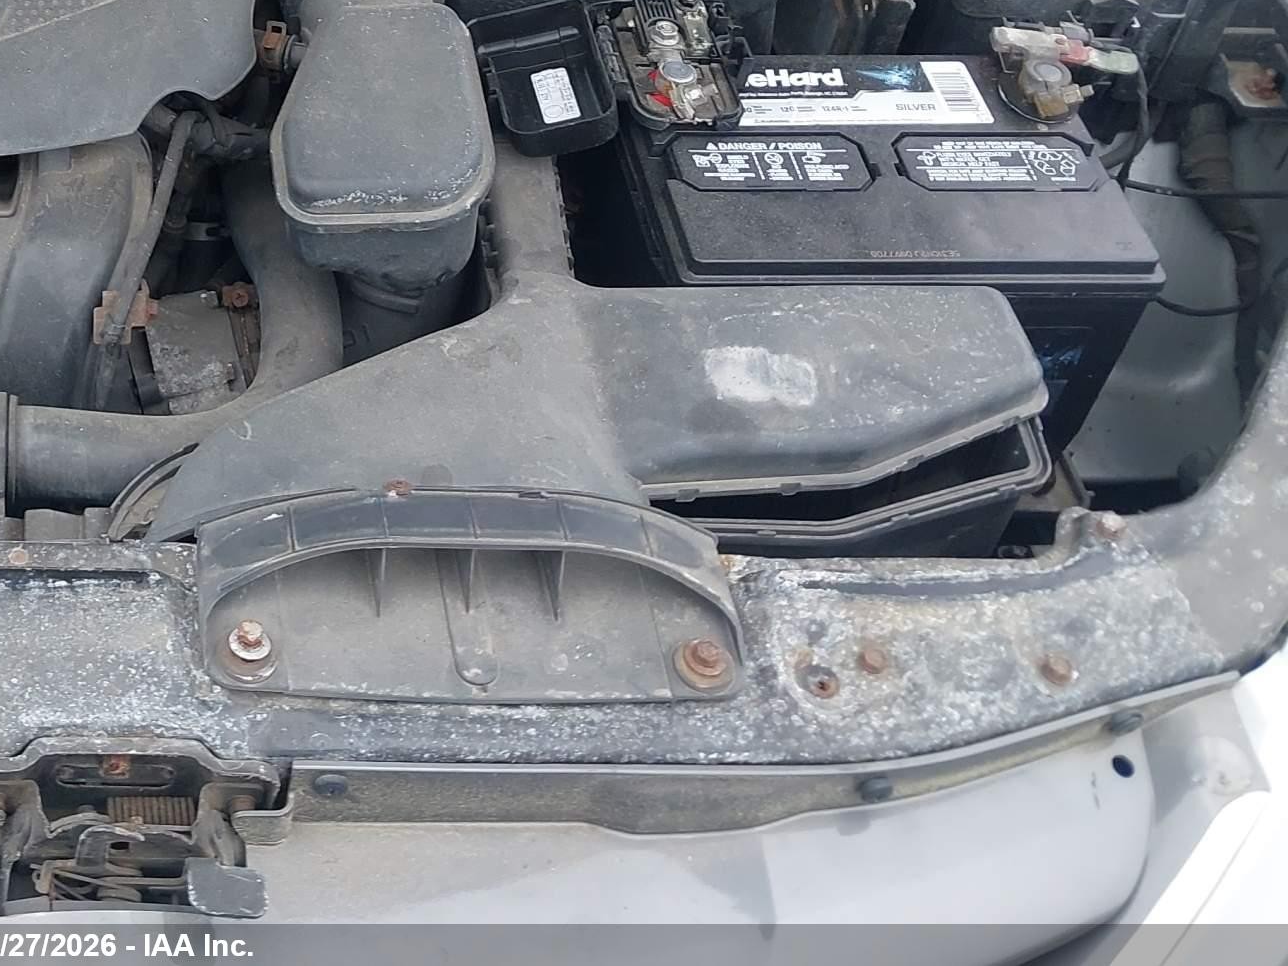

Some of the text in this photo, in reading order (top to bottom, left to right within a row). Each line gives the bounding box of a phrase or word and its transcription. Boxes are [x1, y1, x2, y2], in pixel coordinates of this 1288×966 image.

[745, 68, 843, 87] eHard
[895, 103, 936, 111] SILVER
[717, 142, 767, 151] DANGER
[777, 142, 823, 151] POISON
